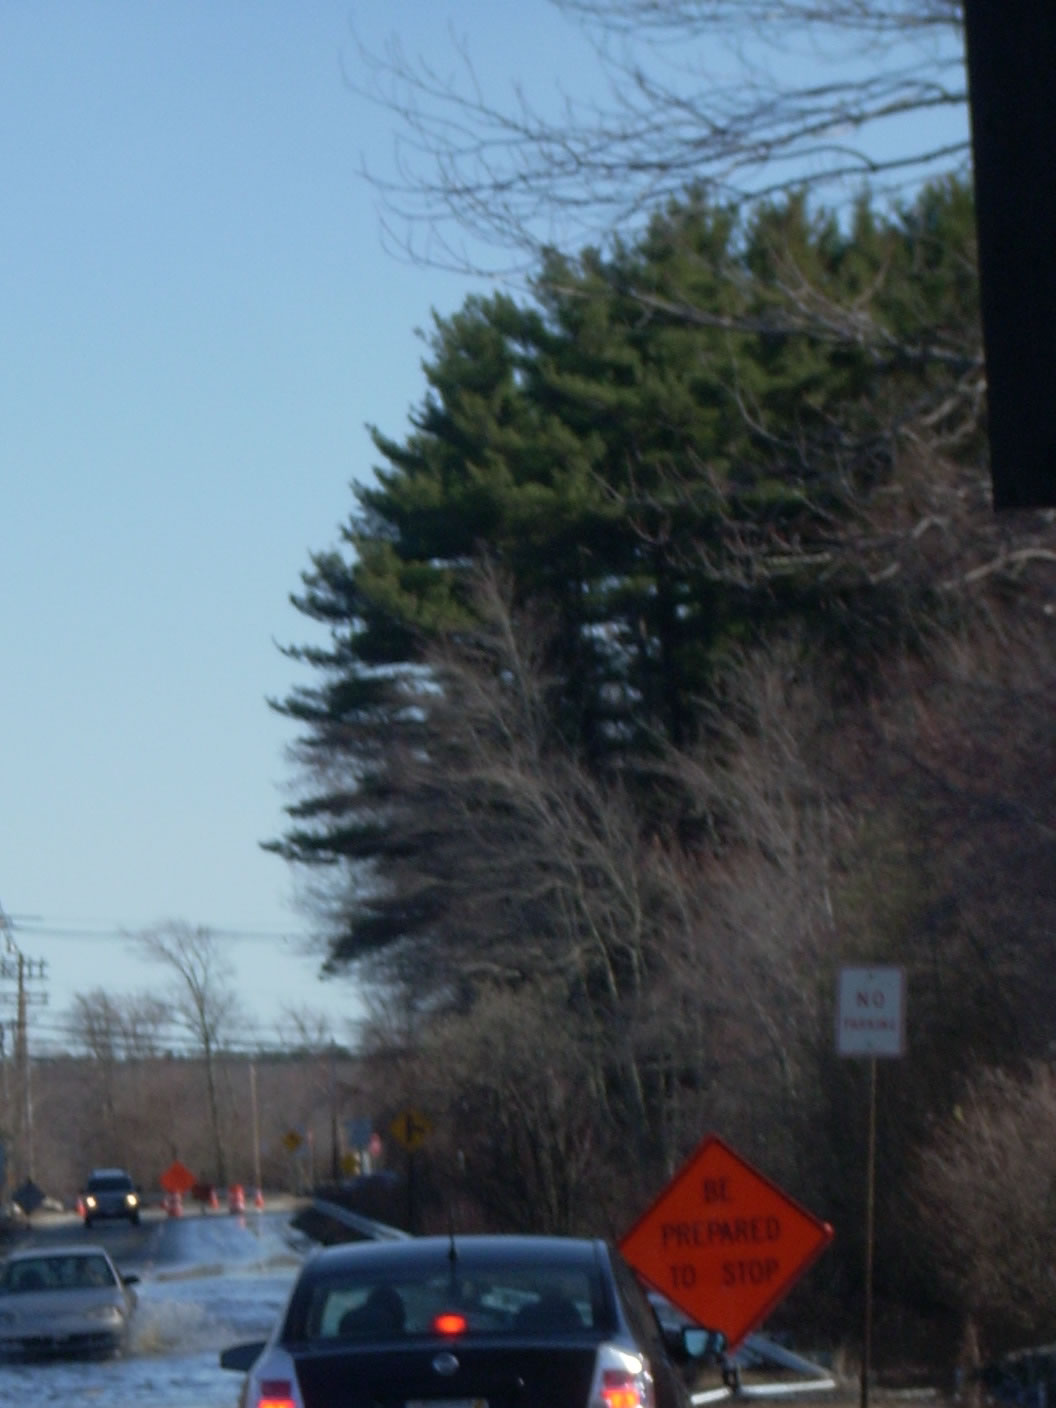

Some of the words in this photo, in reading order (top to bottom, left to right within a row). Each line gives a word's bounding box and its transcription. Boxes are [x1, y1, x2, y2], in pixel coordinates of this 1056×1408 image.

[856, 990, 886, 1009] NO
[702, 1178, 730, 1203] BE
[661, 1216, 781, 1248] PREPARED
[670, 1263, 696, 1289] TO
[722, 1257, 780, 1287] STOP
